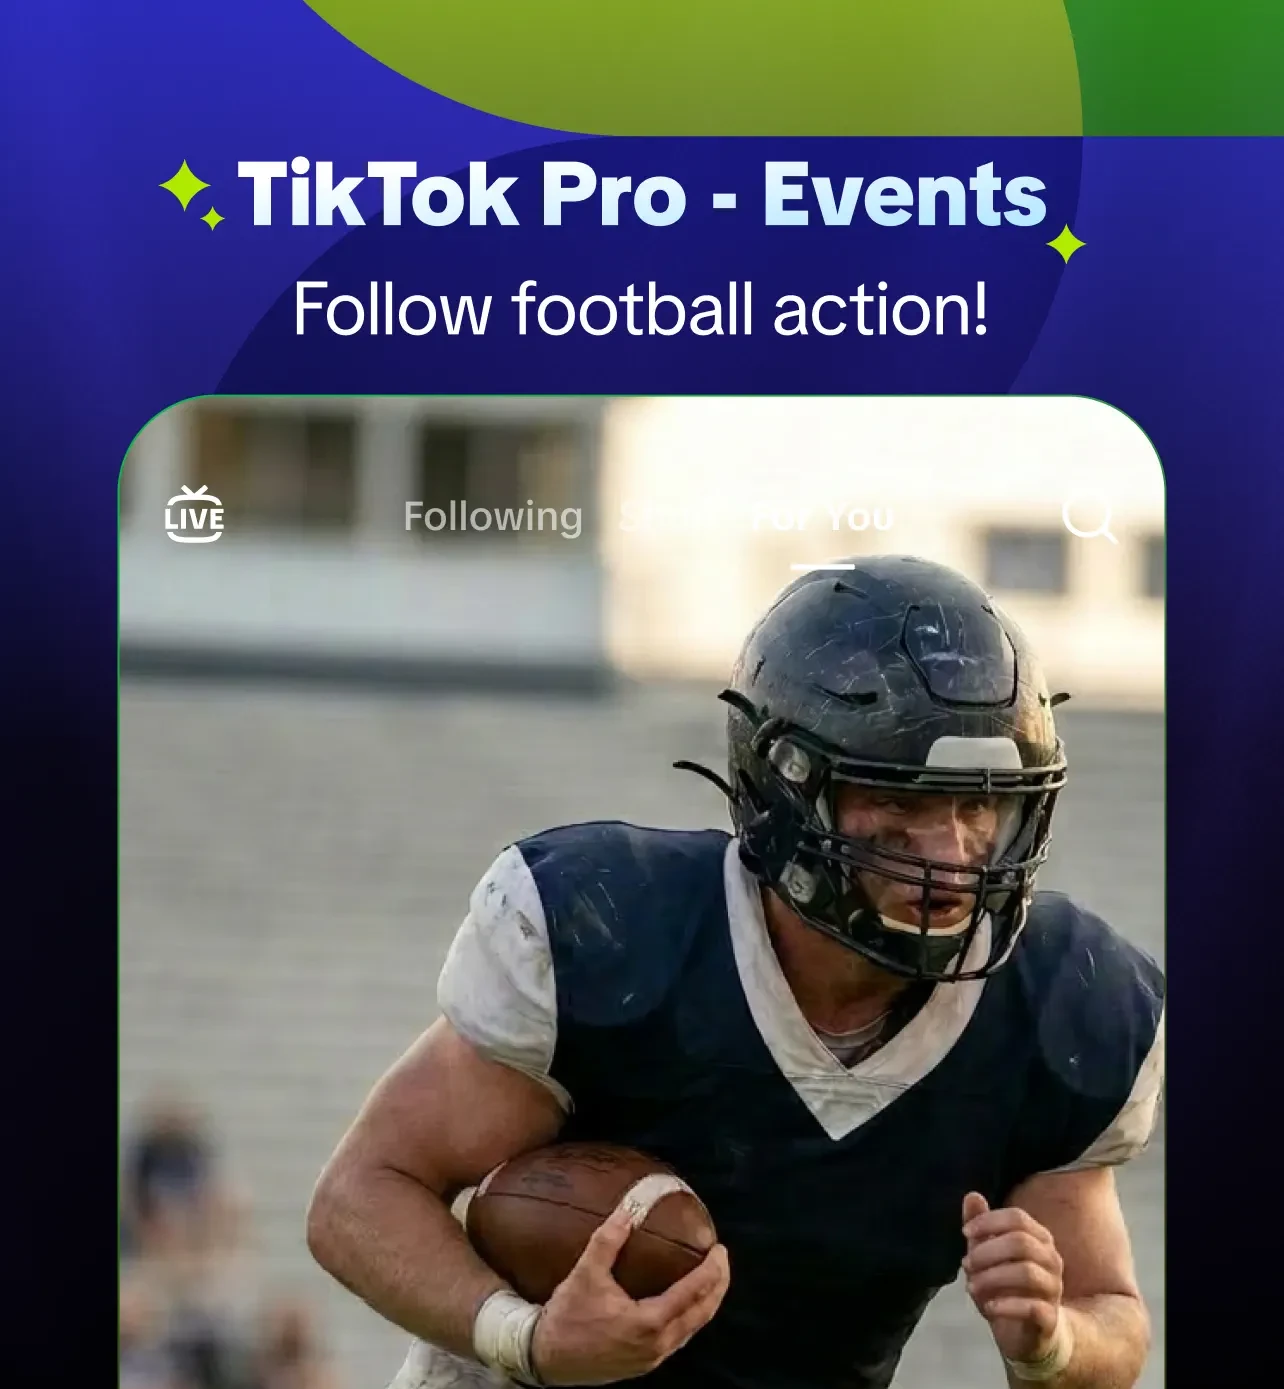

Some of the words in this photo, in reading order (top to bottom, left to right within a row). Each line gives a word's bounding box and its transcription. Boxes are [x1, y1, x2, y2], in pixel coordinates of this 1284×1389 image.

[165, 508, 225, 530] LIVE
[405, 499, 583, 540] Following
[751, 501, 813, 532] For
[825, 501, 895, 532] You
